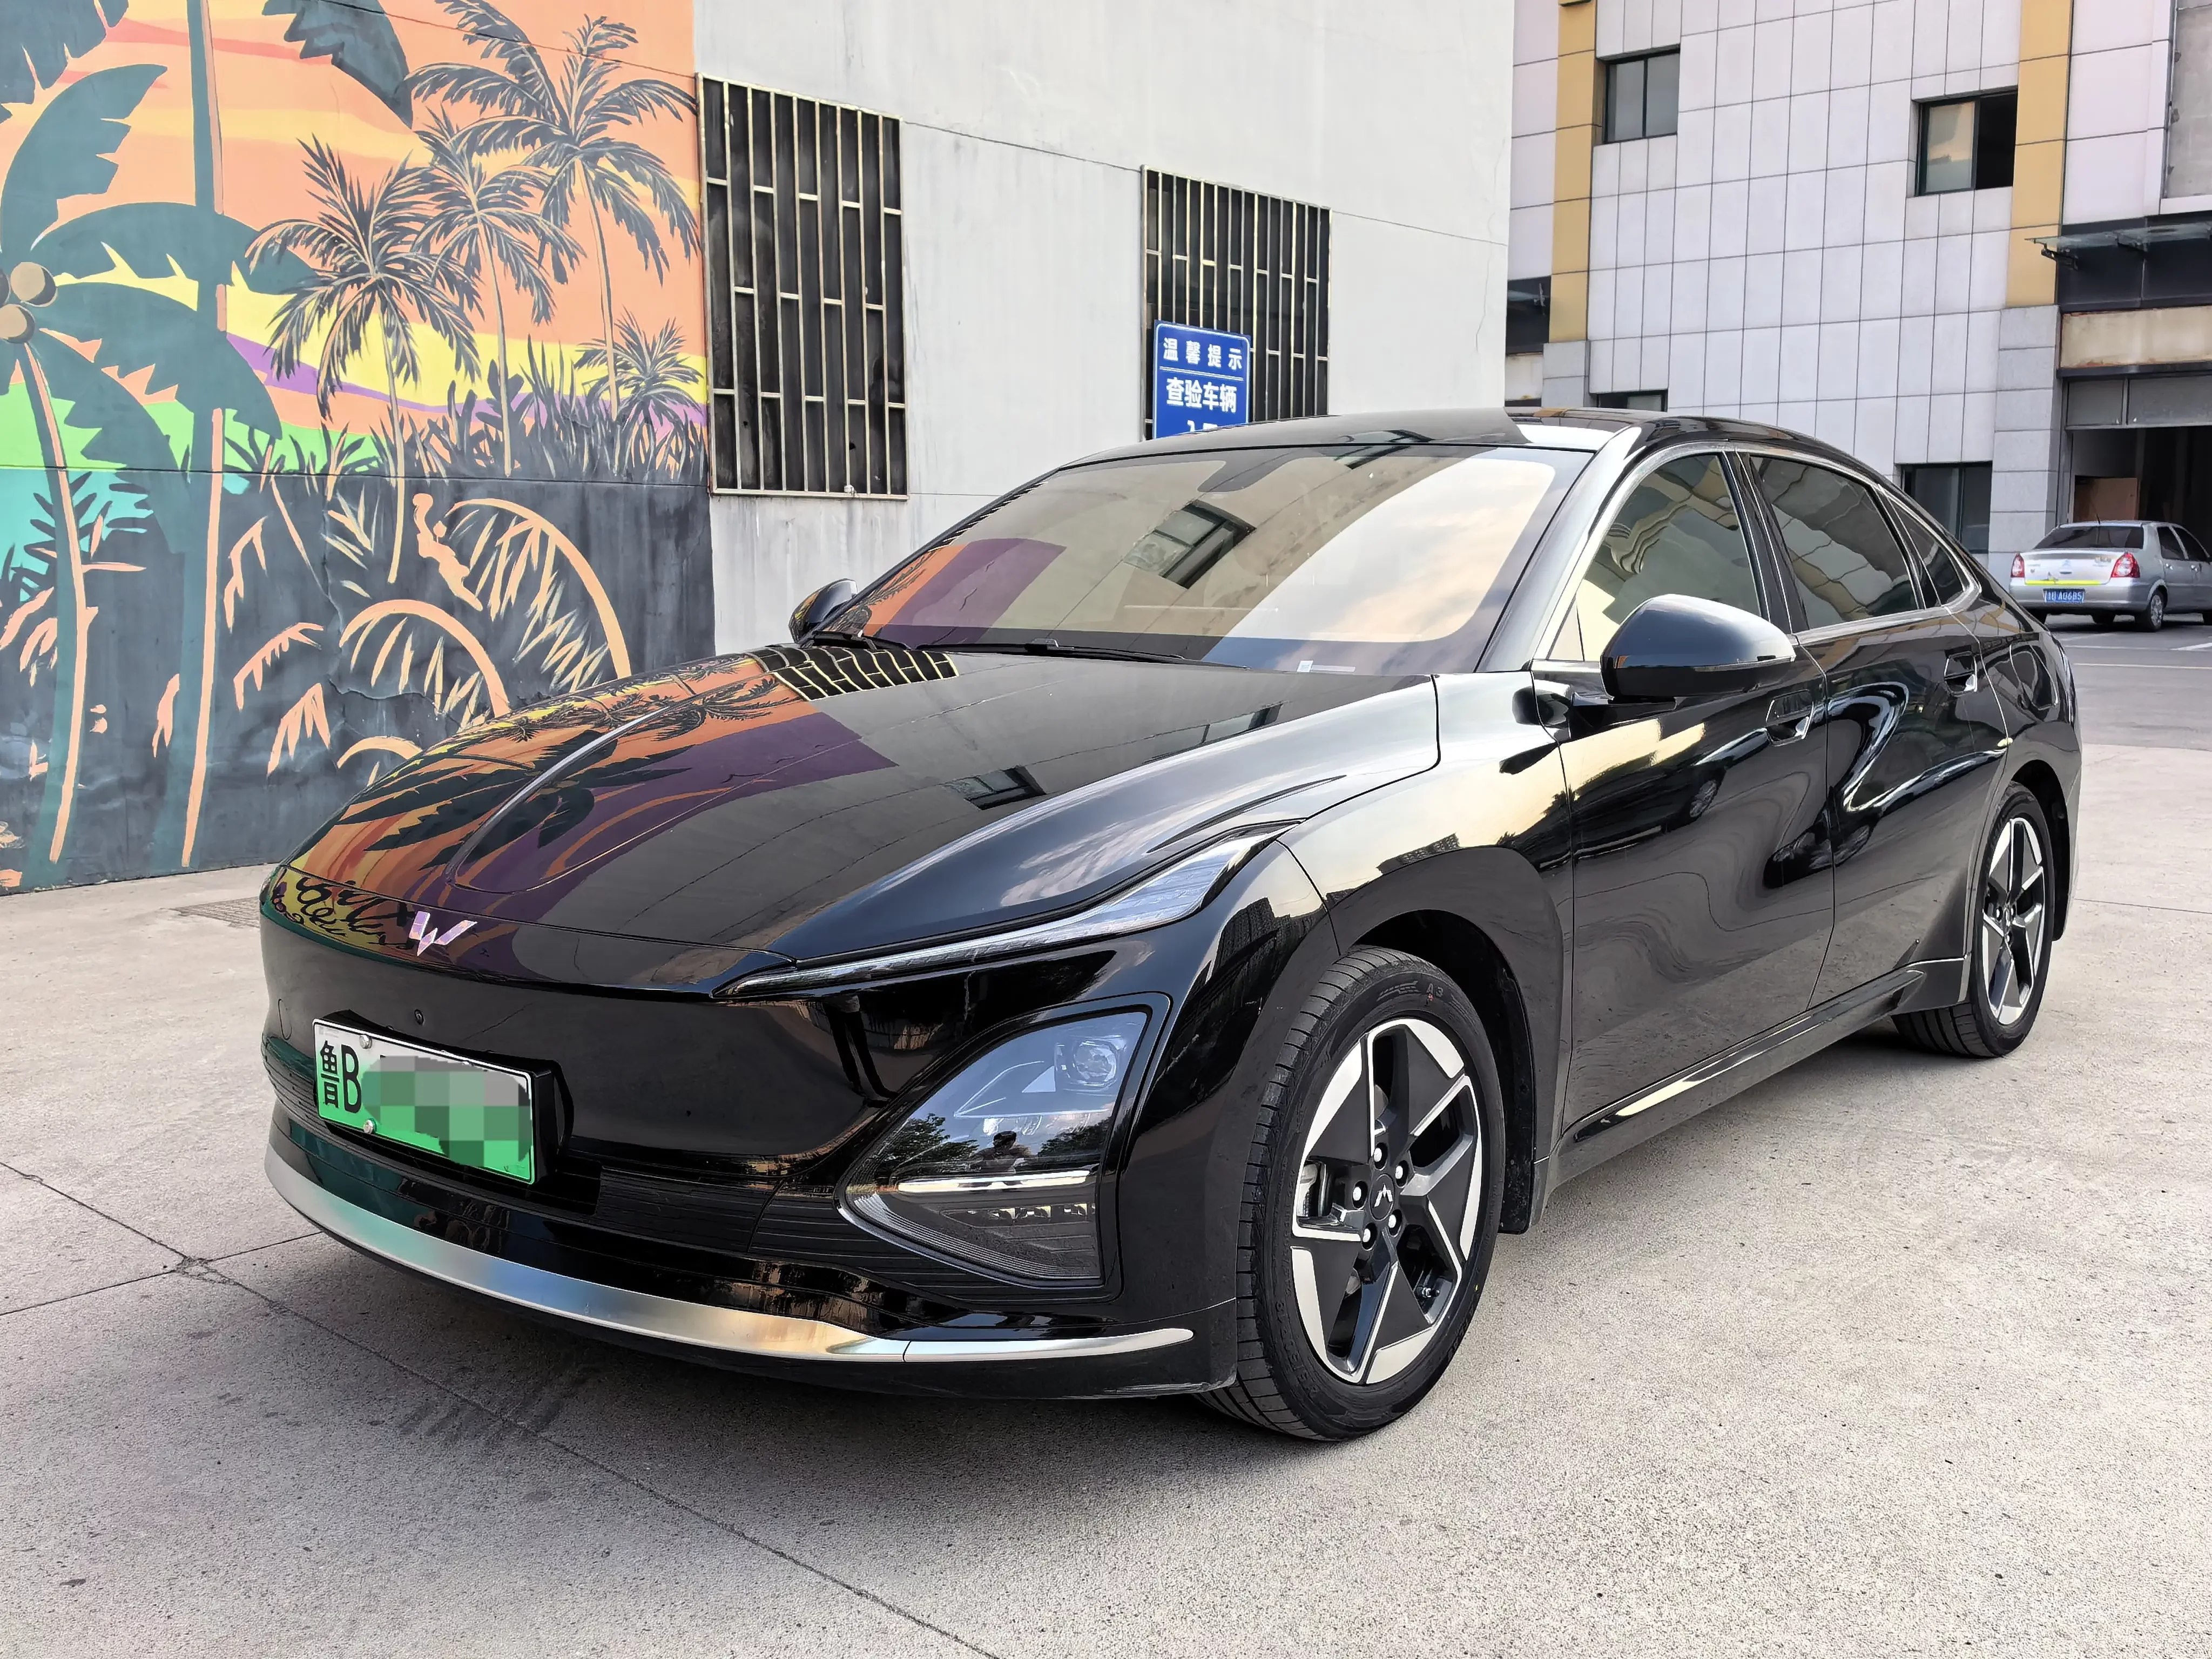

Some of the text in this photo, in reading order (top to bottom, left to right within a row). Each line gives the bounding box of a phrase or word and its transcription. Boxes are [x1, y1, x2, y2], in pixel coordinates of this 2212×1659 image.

[1163, 337, 1242, 371] 温馨提示
[1166, 376, 1237, 413] 查验车辆
